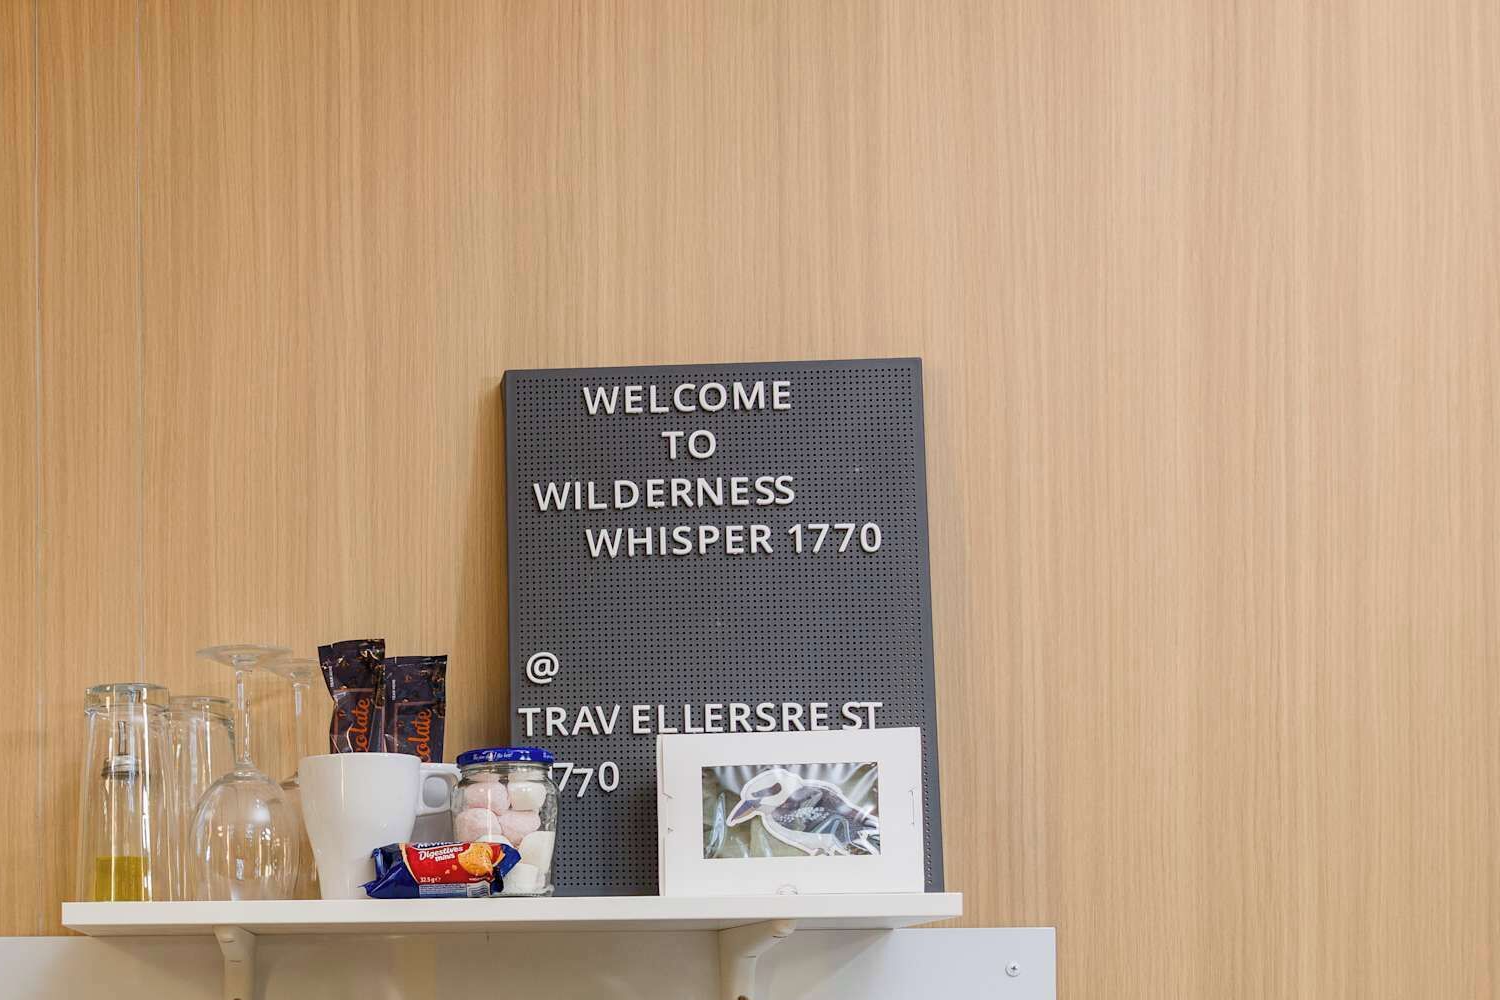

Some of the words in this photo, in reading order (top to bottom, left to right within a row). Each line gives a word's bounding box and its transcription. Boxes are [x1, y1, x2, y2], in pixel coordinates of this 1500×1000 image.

[583, 380, 792, 415] WELCOME
[661, 429, 717, 460] TO
[533, 475, 795, 511] WILDERNESS
[586, 523, 773, 558] WHISPER
[788, 522, 882, 554] 1770
[525, 651, 560, 684] @
[350, 697, 371, 752] olate
[418, 847, 464, 861] Digestives
